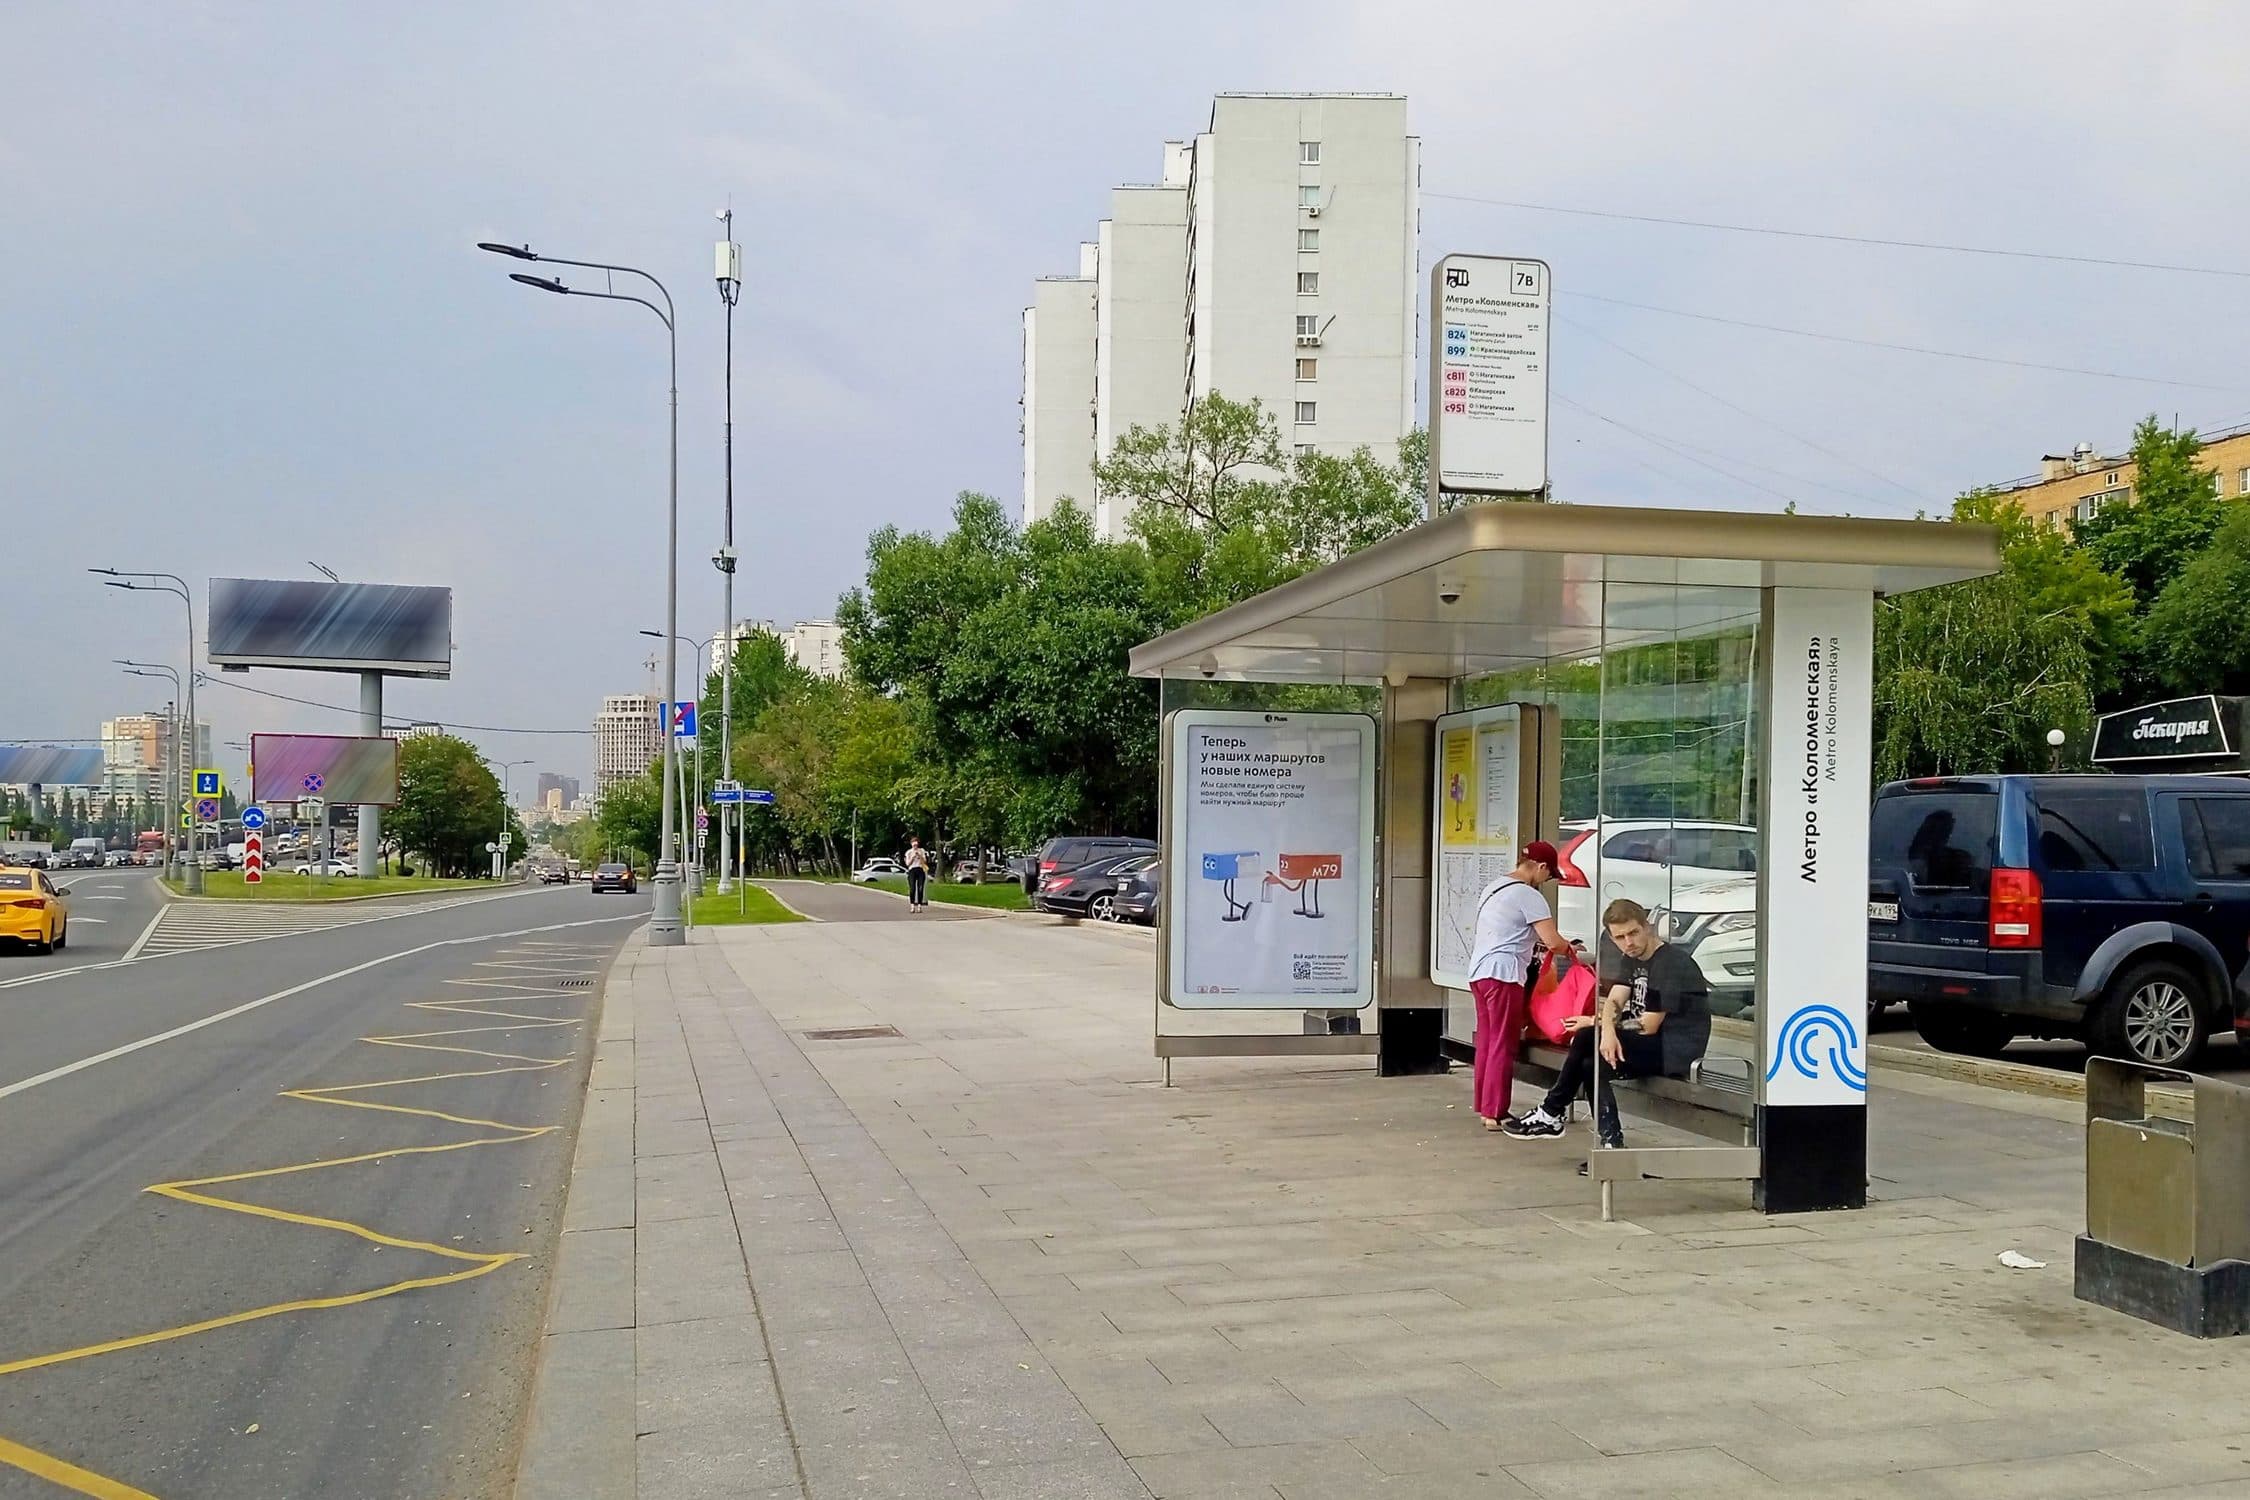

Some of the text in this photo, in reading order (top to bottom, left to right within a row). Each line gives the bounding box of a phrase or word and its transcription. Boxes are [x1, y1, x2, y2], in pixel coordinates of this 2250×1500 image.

[1446, 295, 1474, 305] Метро
[1447, 330, 1466, 340] 824
[1447, 346, 1466, 356] 899
[1825, 637, 1840, 782] Metro Kolomenskaya
[2132, 716, 2210, 744] Пекарня
[1200, 735, 1247, 749] Теперь
[1200, 752, 1326, 766] у наших маршрутов
[1801, 636, 1821, 883] Метро «Коломенская»
[1200, 766, 1292, 779] новые номера
[1276, 783, 1306, 791] систему
